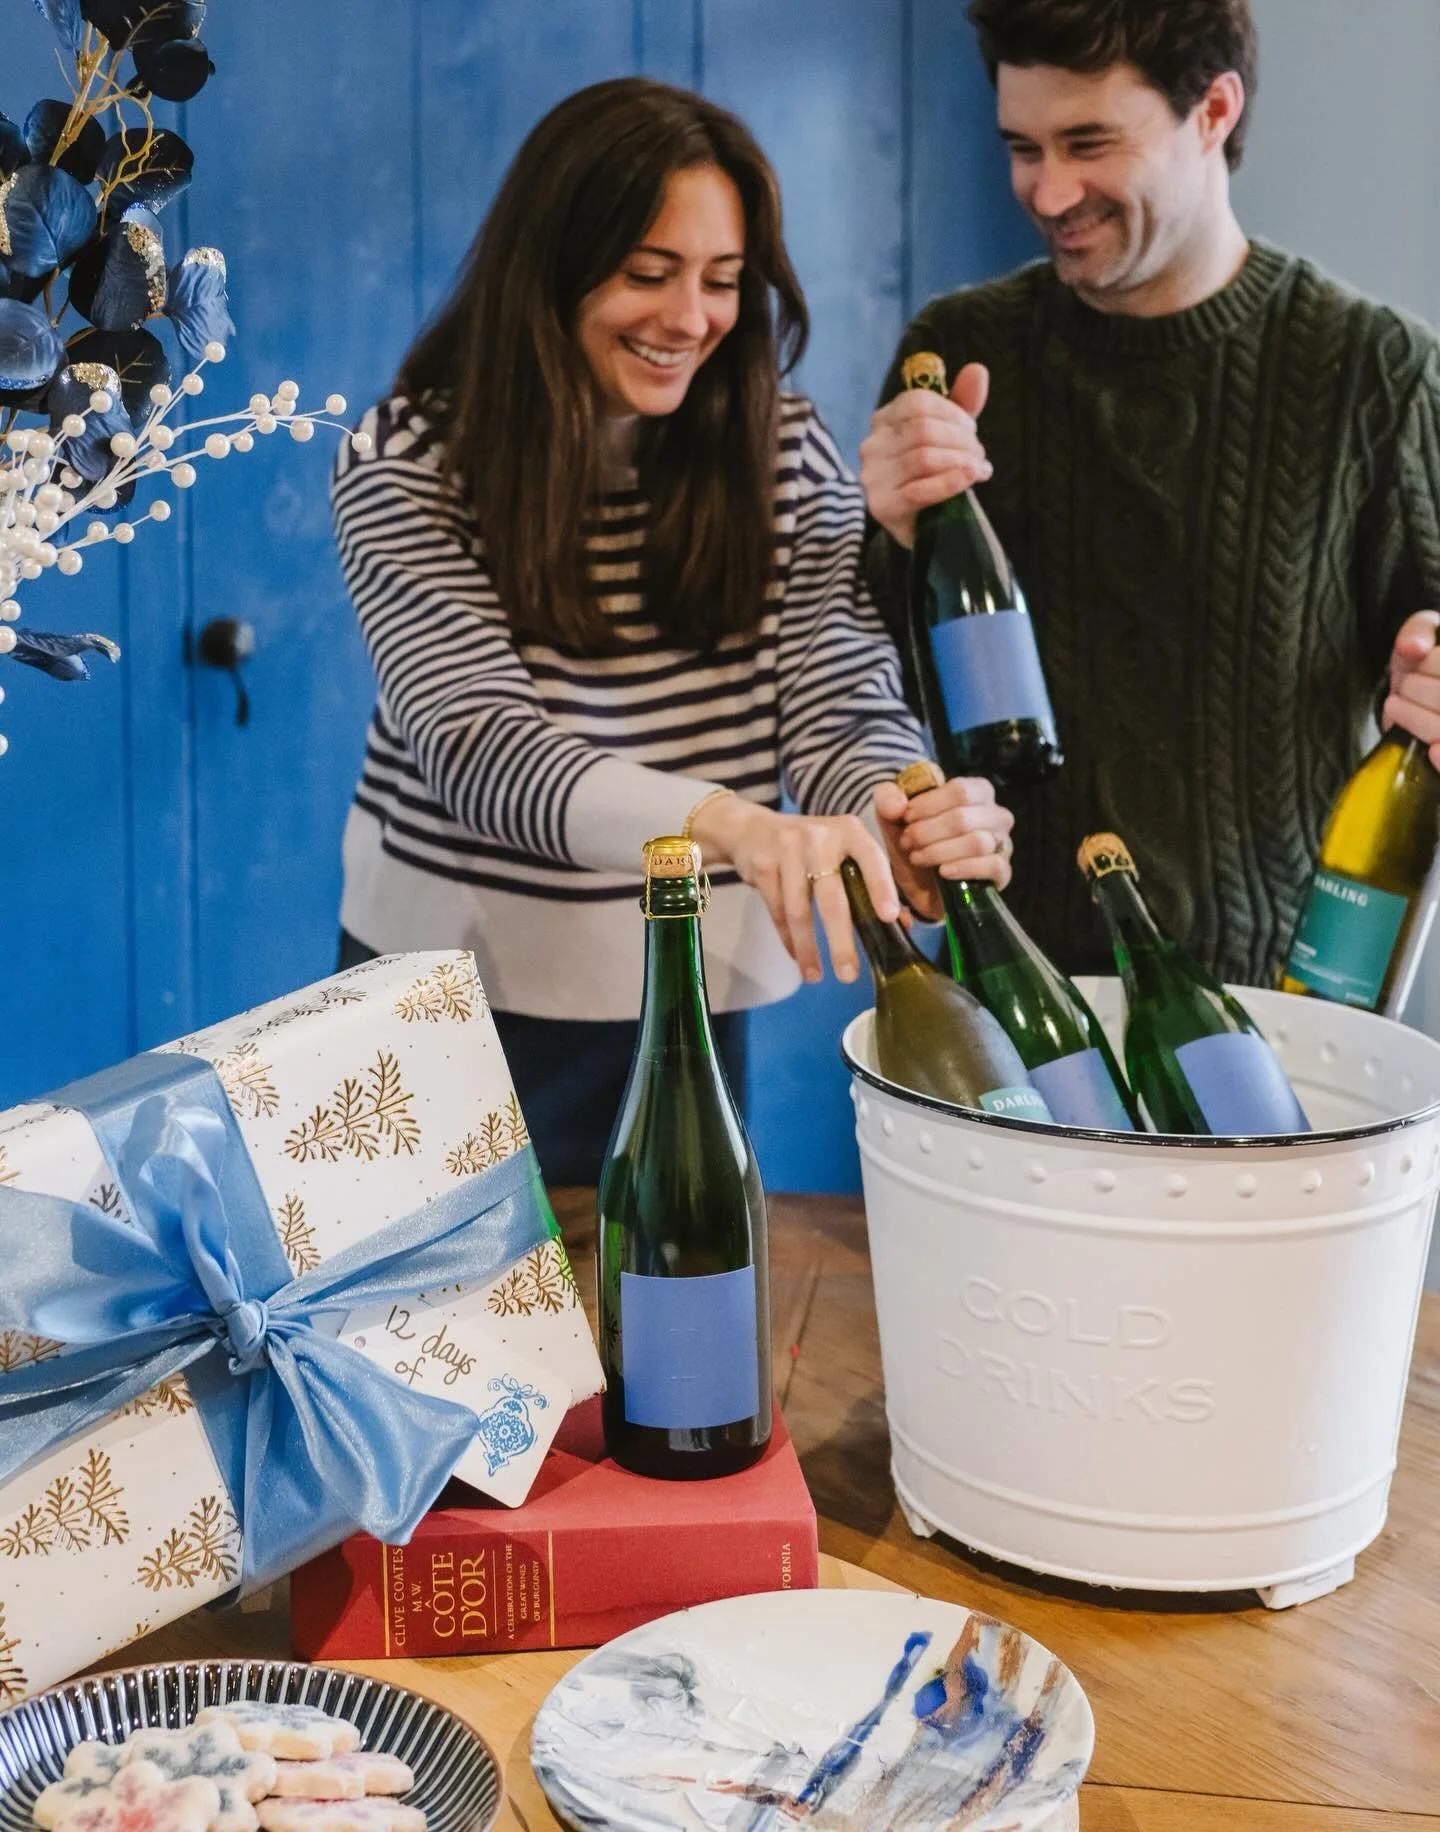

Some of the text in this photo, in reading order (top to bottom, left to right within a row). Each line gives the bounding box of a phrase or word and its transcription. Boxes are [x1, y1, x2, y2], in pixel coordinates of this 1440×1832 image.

[960, 1275, 1173, 1349] COLD
[386, 1305, 477, 1385] 12 days
[394, 1357, 426, 1385] of
[935, 1329, 1215, 1424] DRINKS
[505, 1543, 513, 1561] THE
[506, 1563, 513, 1574] OF
[393, 1547, 406, 1646] CLIVE COATES
[411, 1580, 422, 1612] M.W.
[460, 1548, 487, 1637] D'OR
[506, 1575, 515, 1633] CELEBRATION
[519, 1563, 528, 1620] GREAT WINES
[532, 1560, 541, 1621] OF BURGUNDY
